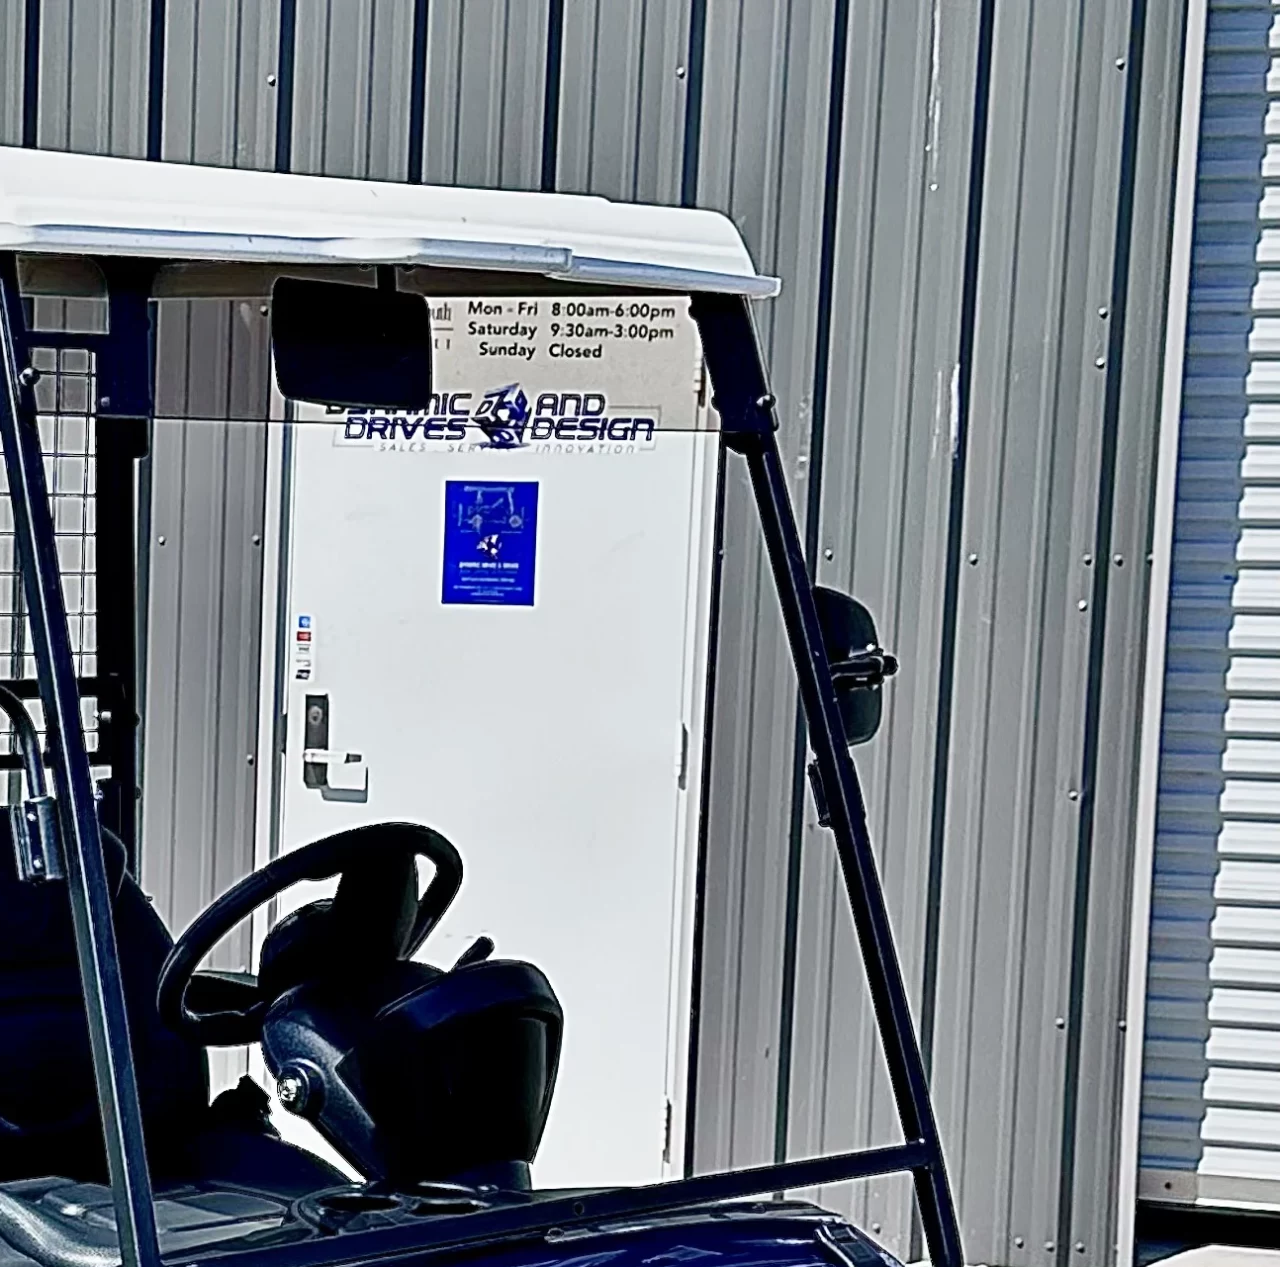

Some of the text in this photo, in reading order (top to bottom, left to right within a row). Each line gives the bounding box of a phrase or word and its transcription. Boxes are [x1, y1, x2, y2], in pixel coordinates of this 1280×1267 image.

[468, 302, 502, 315] Mon
[518, 303, 538, 315] Fri
[551, 303, 676, 320] 8:00am-6:00pm
[468, 321, 675, 342] Saturday 9:30am-3:00pm
[478, 342, 603, 360] Sunday Closed
[535, 393, 606, 416] AND
[344, 417, 655, 441] DRIVES DESIGN
[379, 443, 427, 452] SALES
[535, 444, 635, 454] INNOVATION
